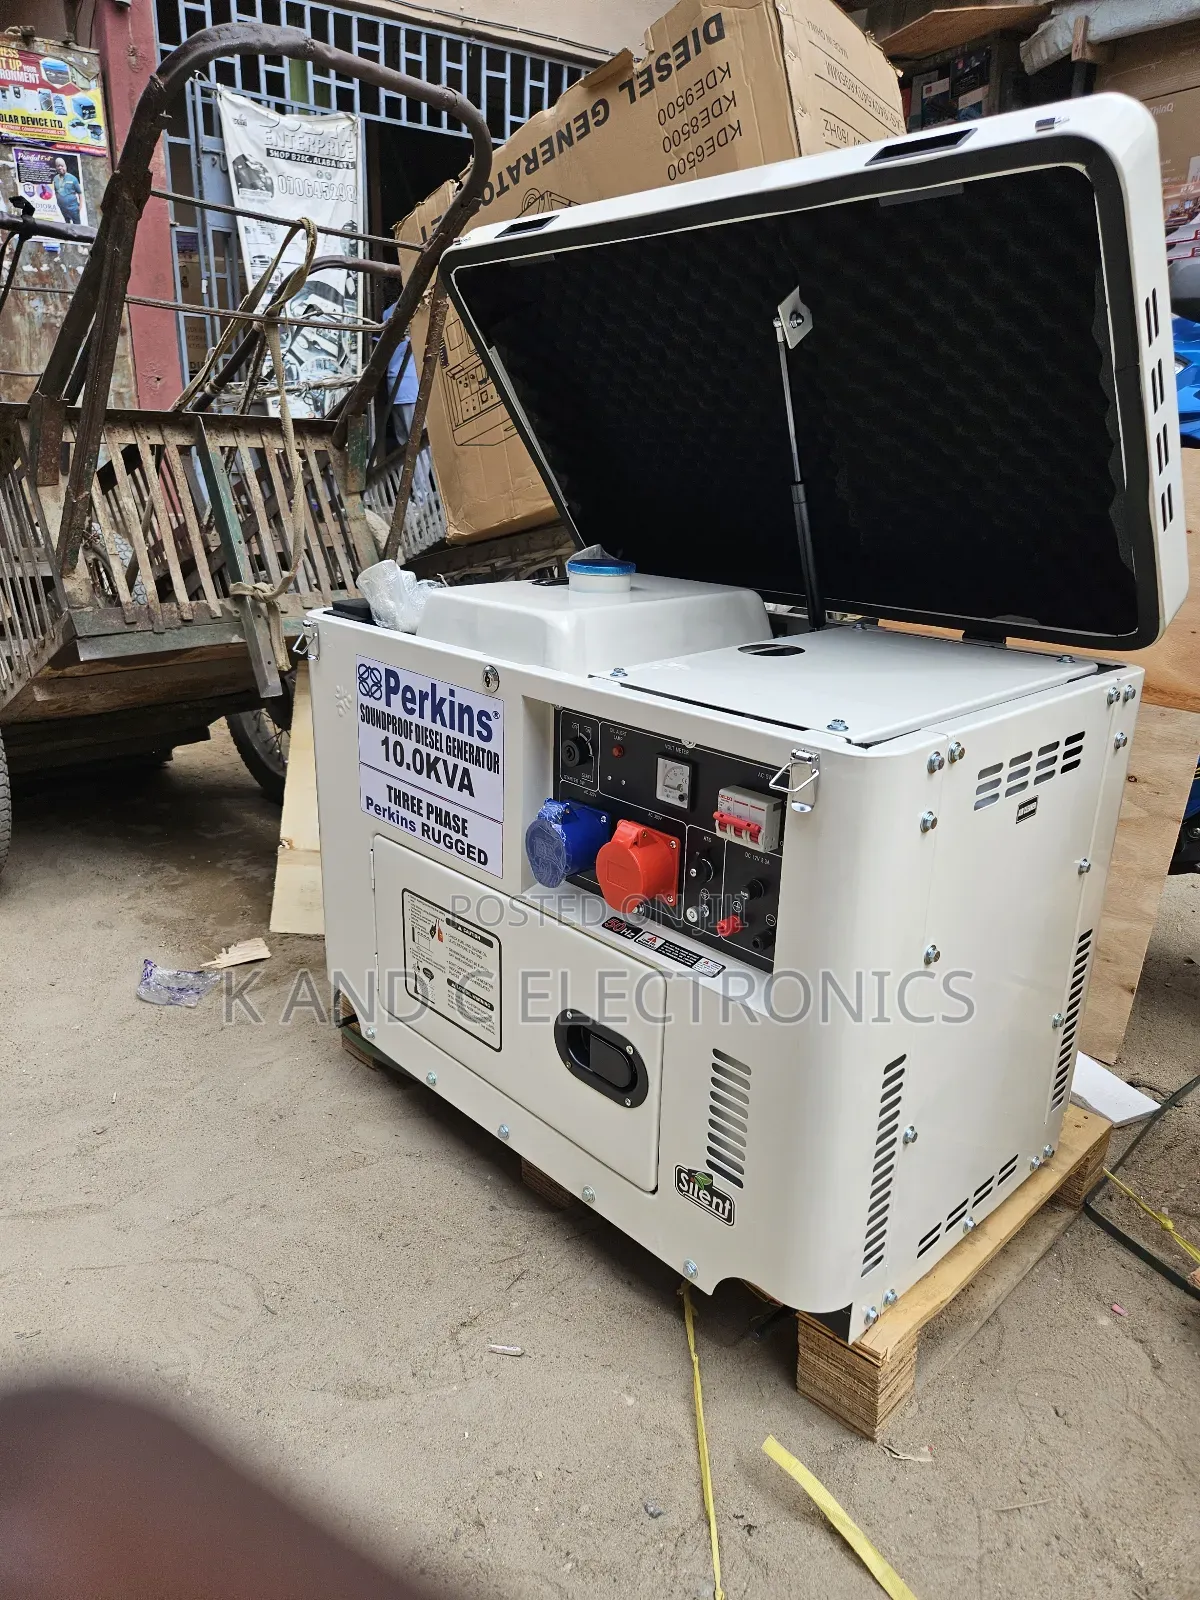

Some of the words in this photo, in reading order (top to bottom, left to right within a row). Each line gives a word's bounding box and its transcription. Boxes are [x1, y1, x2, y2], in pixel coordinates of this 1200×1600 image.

[9, 58, 22, 71] UP
[618, 12, 725, 105] DIESEL
[21, 116, 49, 127] DEVICE
[657, 61, 732, 126] KDE9500
[662, 90, 737, 153] KDE8500
[269, 149, 290, 160] SHOP
[313, 156, 336, 167] ALABA
[481, 98, 610, 207] GENERATO
[667, 119, 743, 181] KDE6500
[359, 702, 414, 741] SOUNDPROOF
[414, 718, 444, 752] DIESEL
[445, 734, 500, 775] GENERATOR
[381, 735, 475, 798] 10.0KVA
[664, 743, 675, 751] VOLT
[365, 795, 417, 833] Perkins
[421, 821, 489, 867] RUGGED
[386, 783, 423, 818] THREE
[426, 801, 469, 838] PHASE
[604, 918, 636, 939] 50Hz
[678, 1171, 731, 1219] Silent
